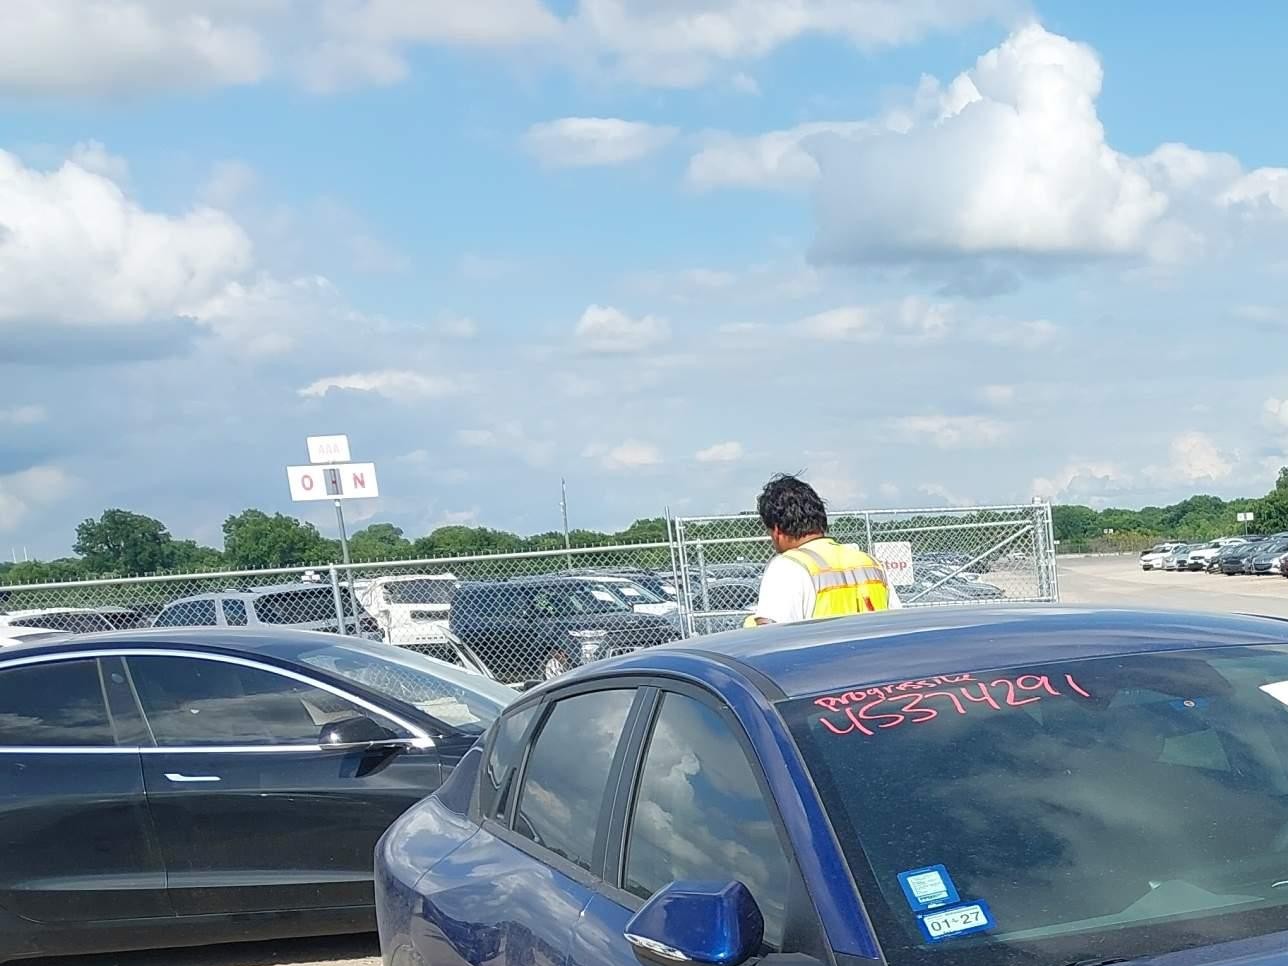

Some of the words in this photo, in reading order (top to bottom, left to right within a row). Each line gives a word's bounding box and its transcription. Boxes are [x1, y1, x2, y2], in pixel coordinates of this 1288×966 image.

[352, 472, 366, 489] N
[882, 559, 908, 571] top
[819, 673, 1091, 736] 45374291
